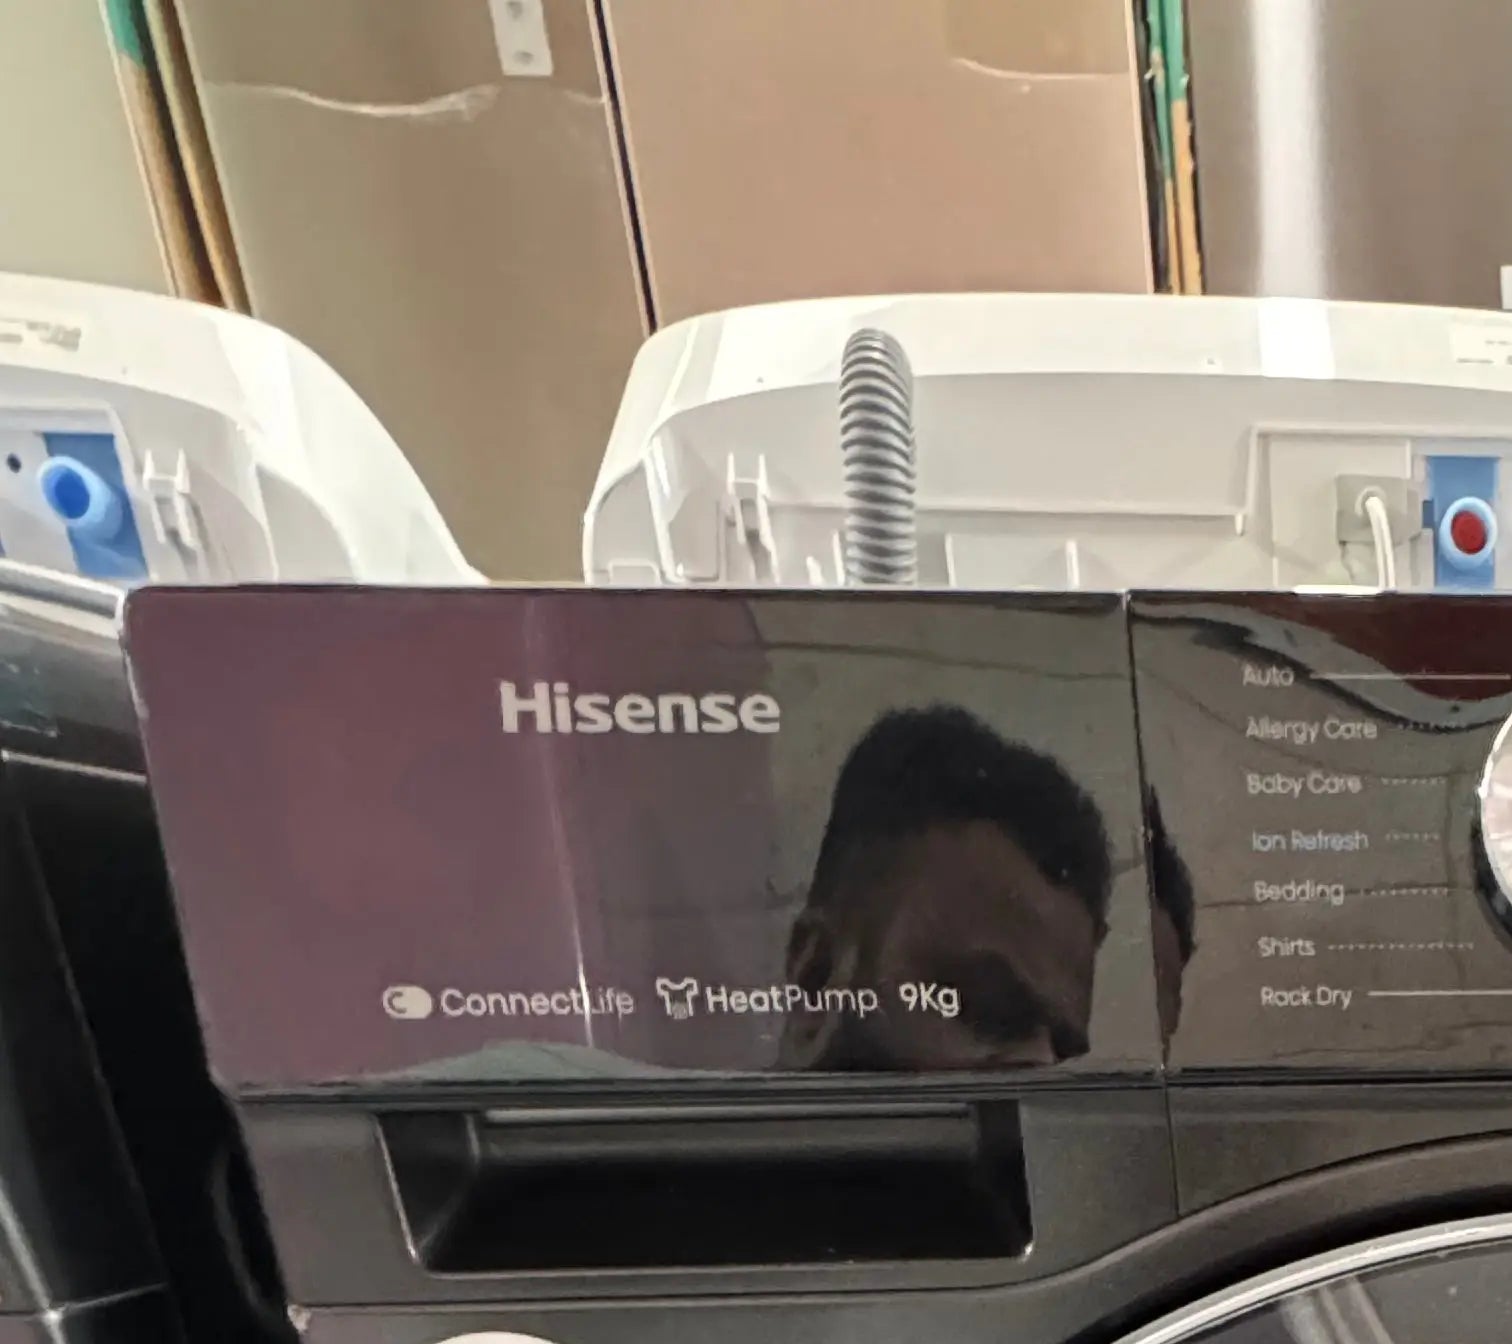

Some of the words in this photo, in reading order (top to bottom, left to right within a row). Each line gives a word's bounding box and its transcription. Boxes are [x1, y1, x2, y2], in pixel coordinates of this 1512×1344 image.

[1242, 664, 1294, 687] Auto
[499, 680, 781, 734] Hisense
[1245, 717, 1319, 745] Allergy
[1323, 719, 1378, 740] Care
[1246, 773, 1304, 799] Baby
[1306, 772, 1363, 794] Care
[1252, 829, 1286, 851] Ion
[1291, 829, 1369, 851] Refresh
[1254, 880, 1345, 906] Bedding
[1257, 936, 1316, 957] Shirts
[440, 988, 635, 1017] ConnectLife
[898, 983, 962, 1018] 9Kg
[1260, 986, 1311, 1006] Rack
[1316, 985, 1353, 1010] Dry
